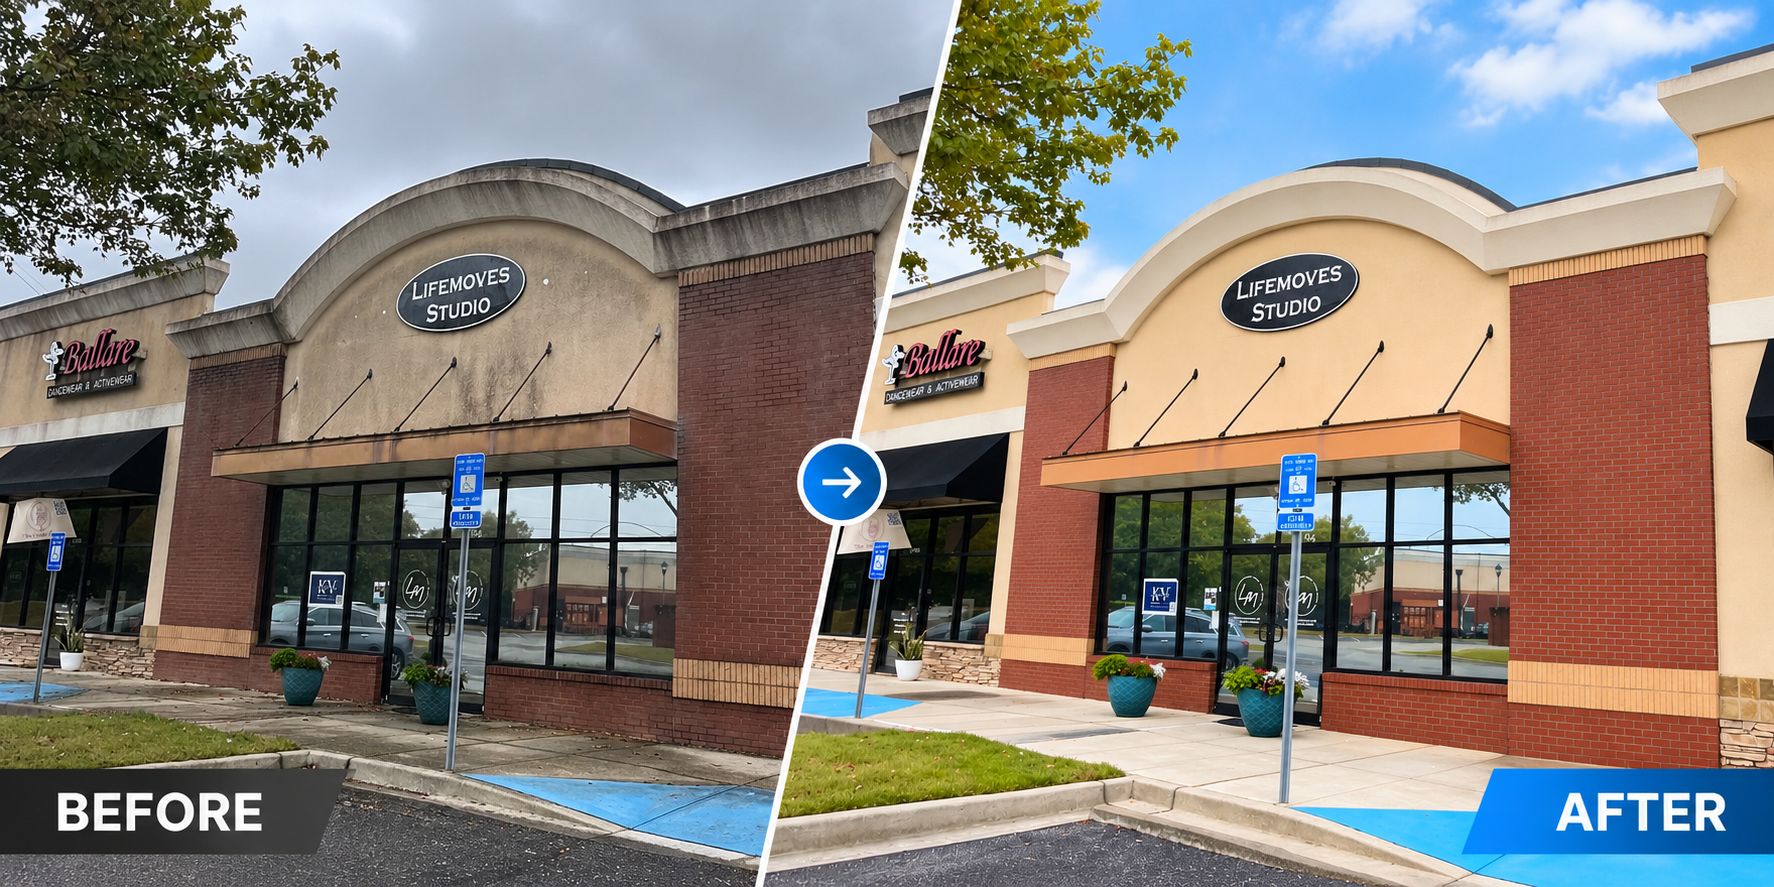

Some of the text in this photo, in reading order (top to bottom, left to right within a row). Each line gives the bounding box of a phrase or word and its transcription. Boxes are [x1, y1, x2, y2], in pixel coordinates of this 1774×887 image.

[412, 266, 510, 301] LIFEMOVES
[1236, 265, 1342, 300] LIFEMOVES
[426, 297, 491, 323] STUDIO
[1251, 295, 1321, 323] STUDIO
[63, 328, 136, 374] Ballare
[903, 328, 982, 378] Ballare
